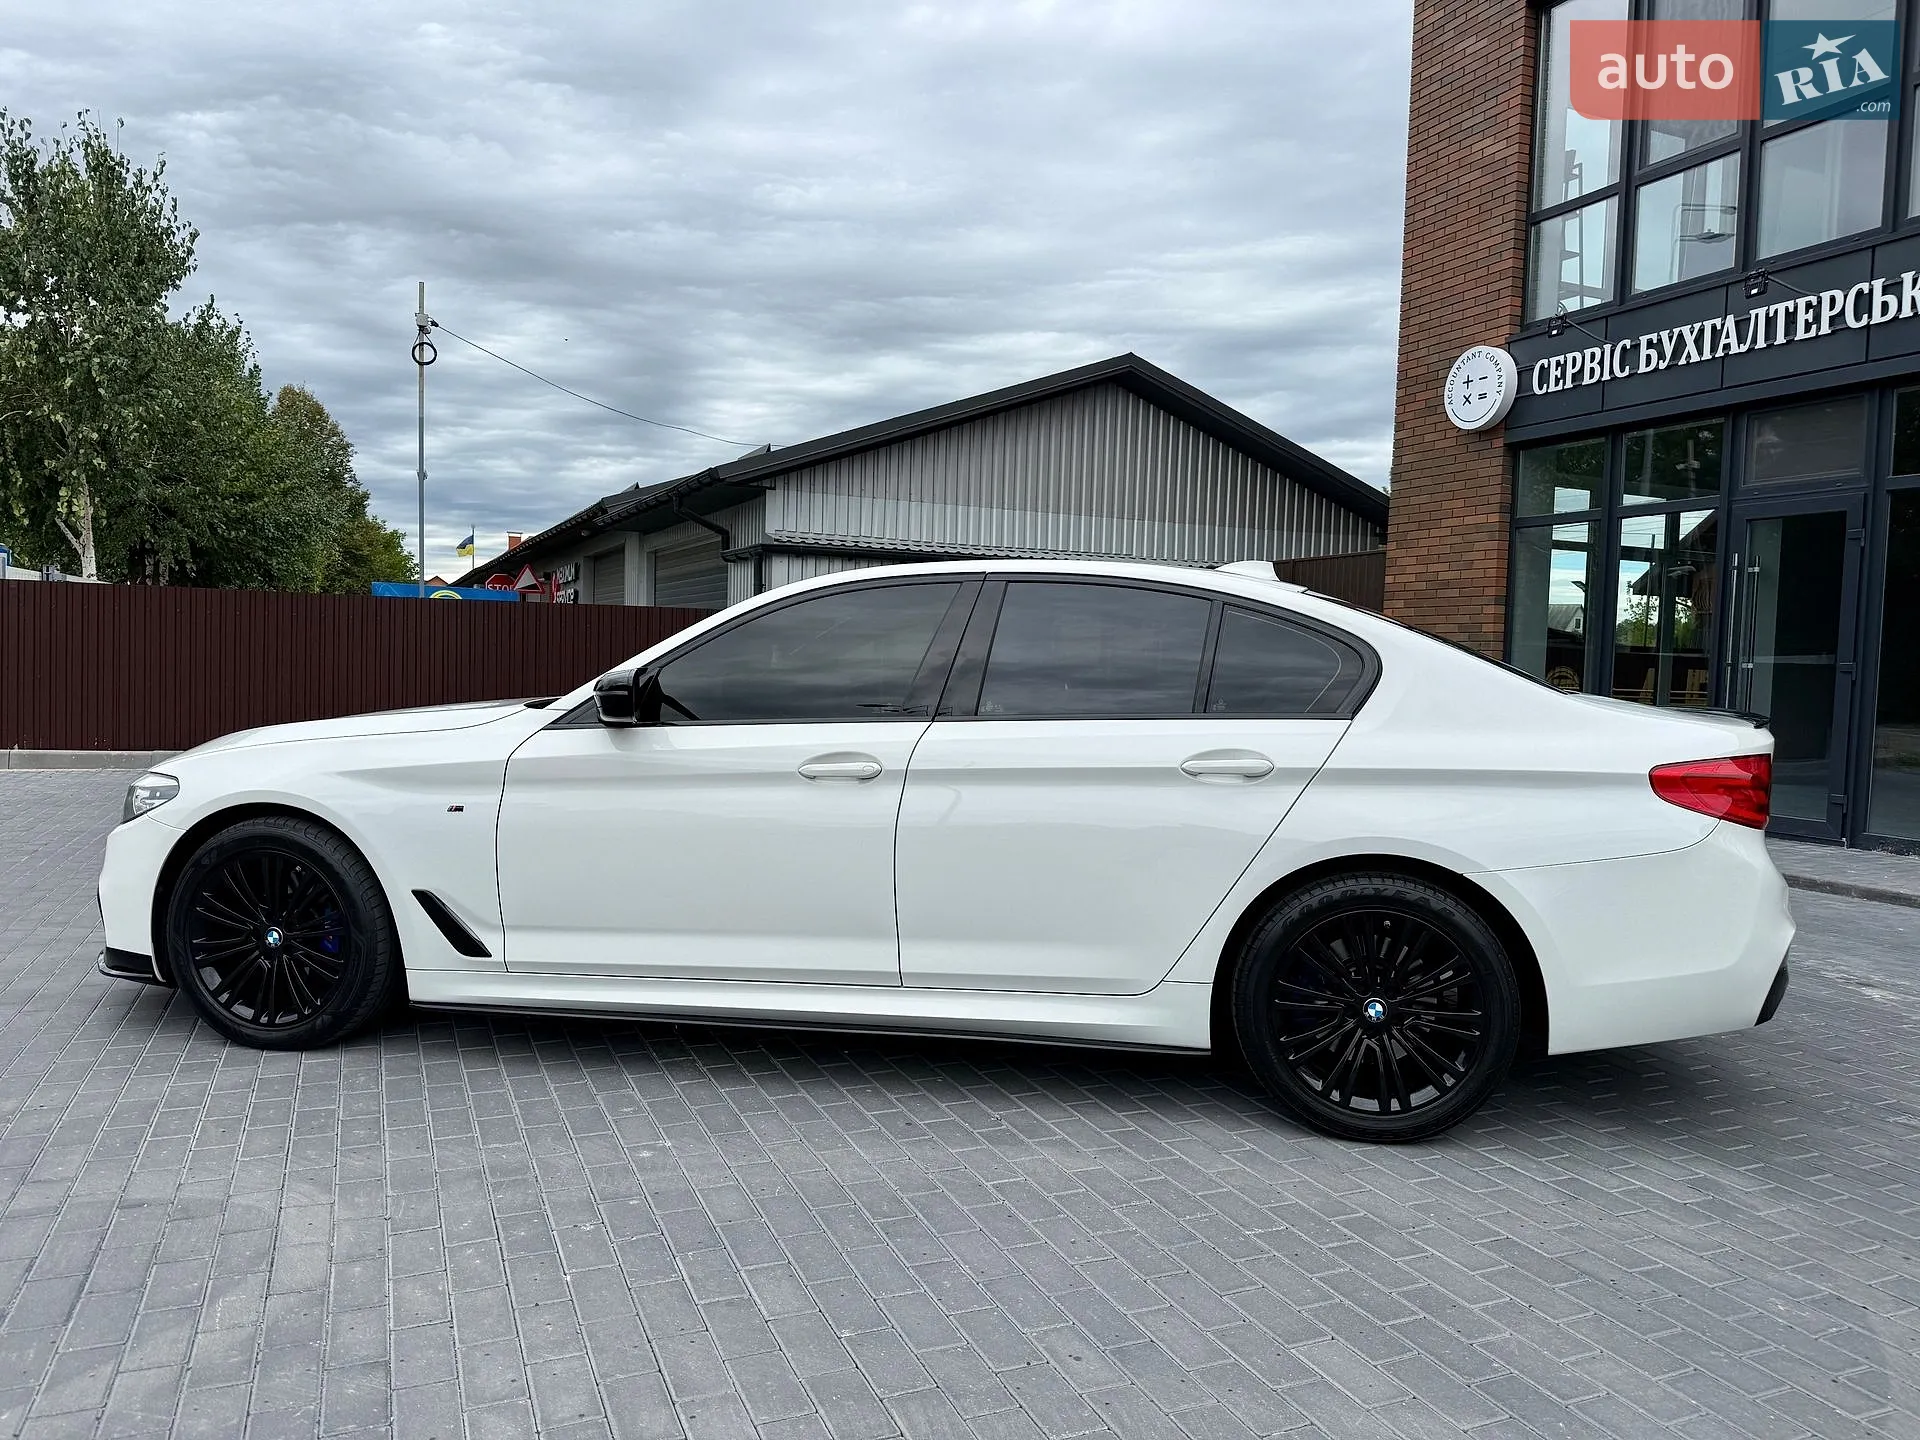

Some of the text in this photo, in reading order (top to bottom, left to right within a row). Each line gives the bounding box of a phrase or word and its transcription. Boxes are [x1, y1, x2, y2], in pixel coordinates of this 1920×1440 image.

[1447, 350, 1504, 405] ACCOUNTANT COMPANY
[1532, 270, 1920, 395] СЕРВІС БУХГАЛТЕРСЬК
